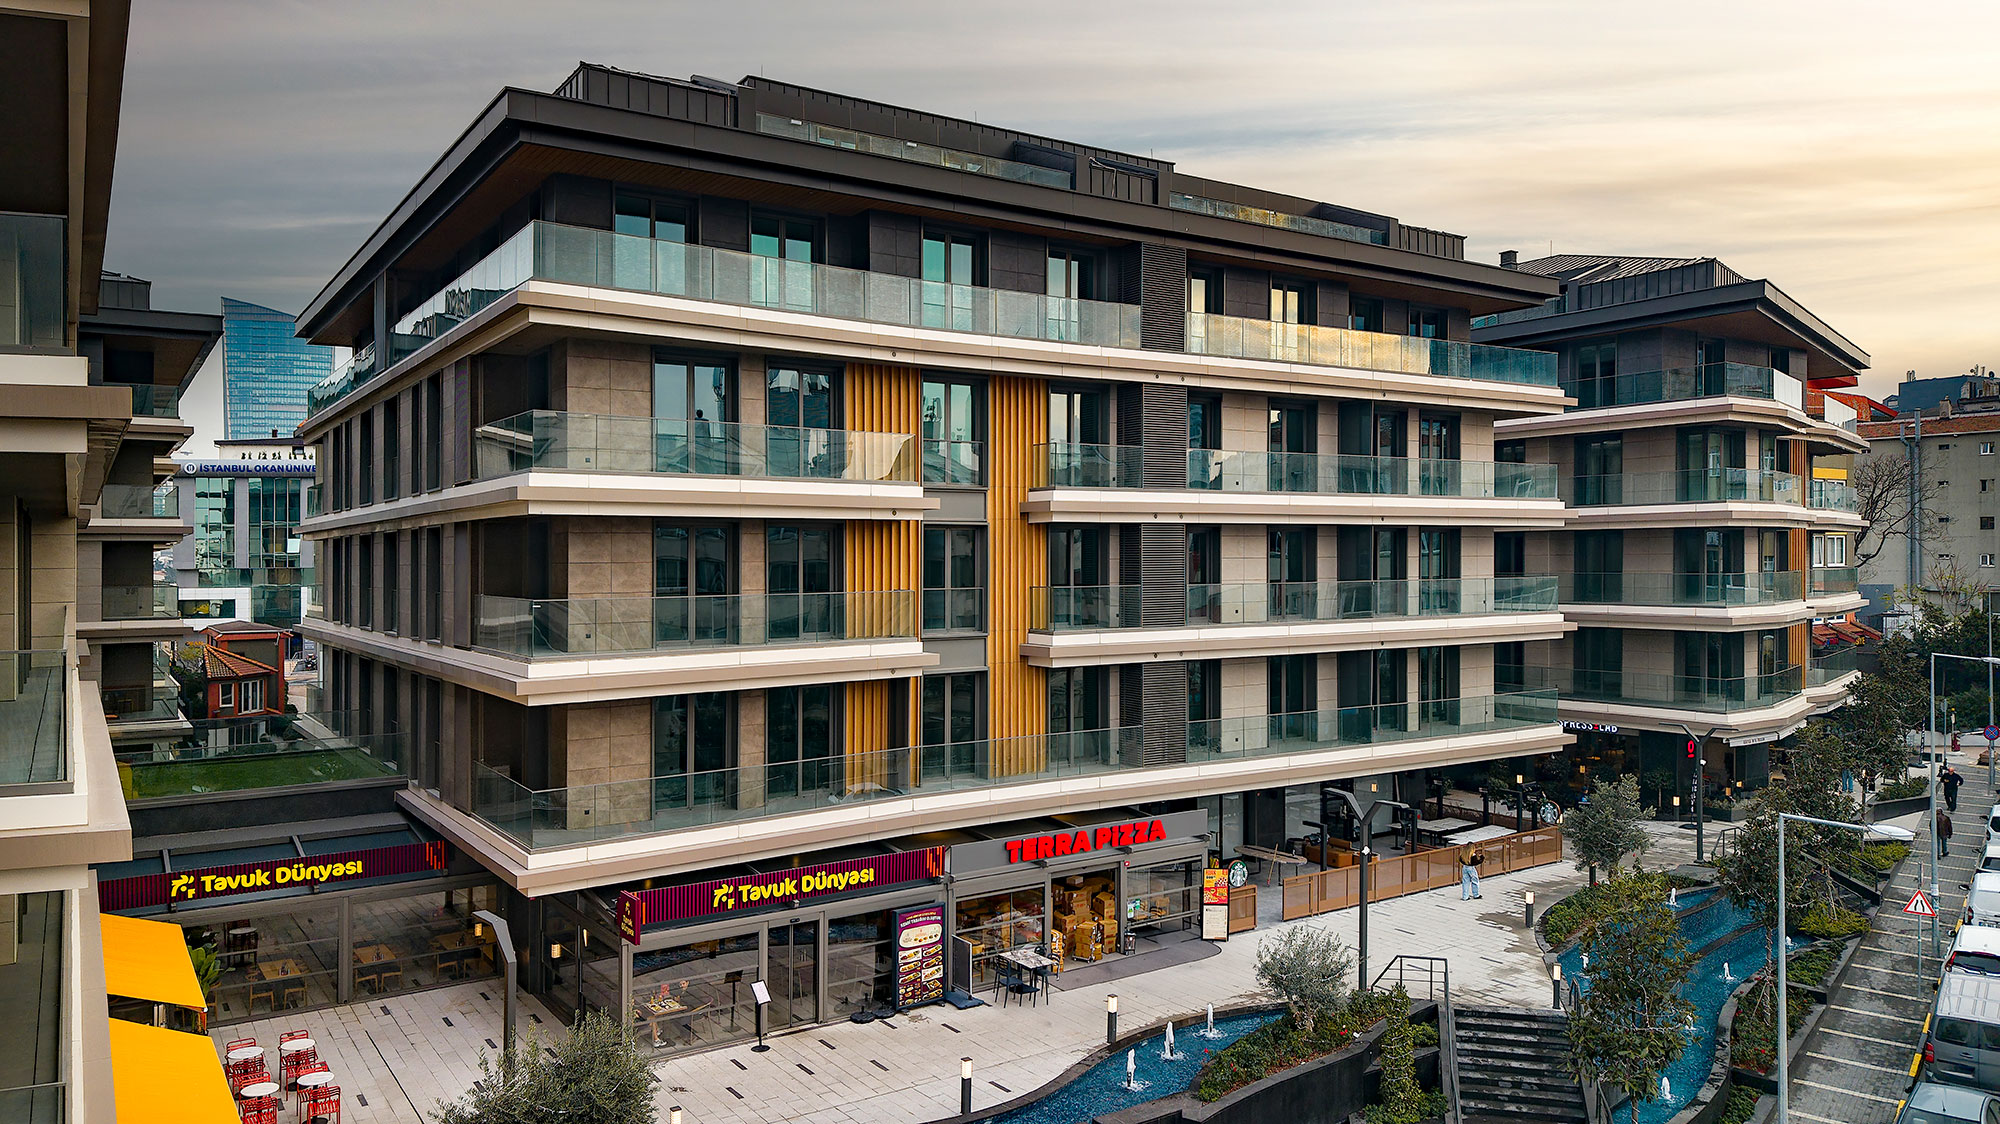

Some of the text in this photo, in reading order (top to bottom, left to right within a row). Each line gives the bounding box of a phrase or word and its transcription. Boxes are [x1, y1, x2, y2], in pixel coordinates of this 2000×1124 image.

[199, 463, 252, 473] İSTANBUL
[254, 464, 284, 473] OKAN
[1006, 830, 1092, 864] TERRA
[200, 860, 363, 893] Tavuk Dünyası
[738, 867, 875, 903] Tavuk Dünyası
